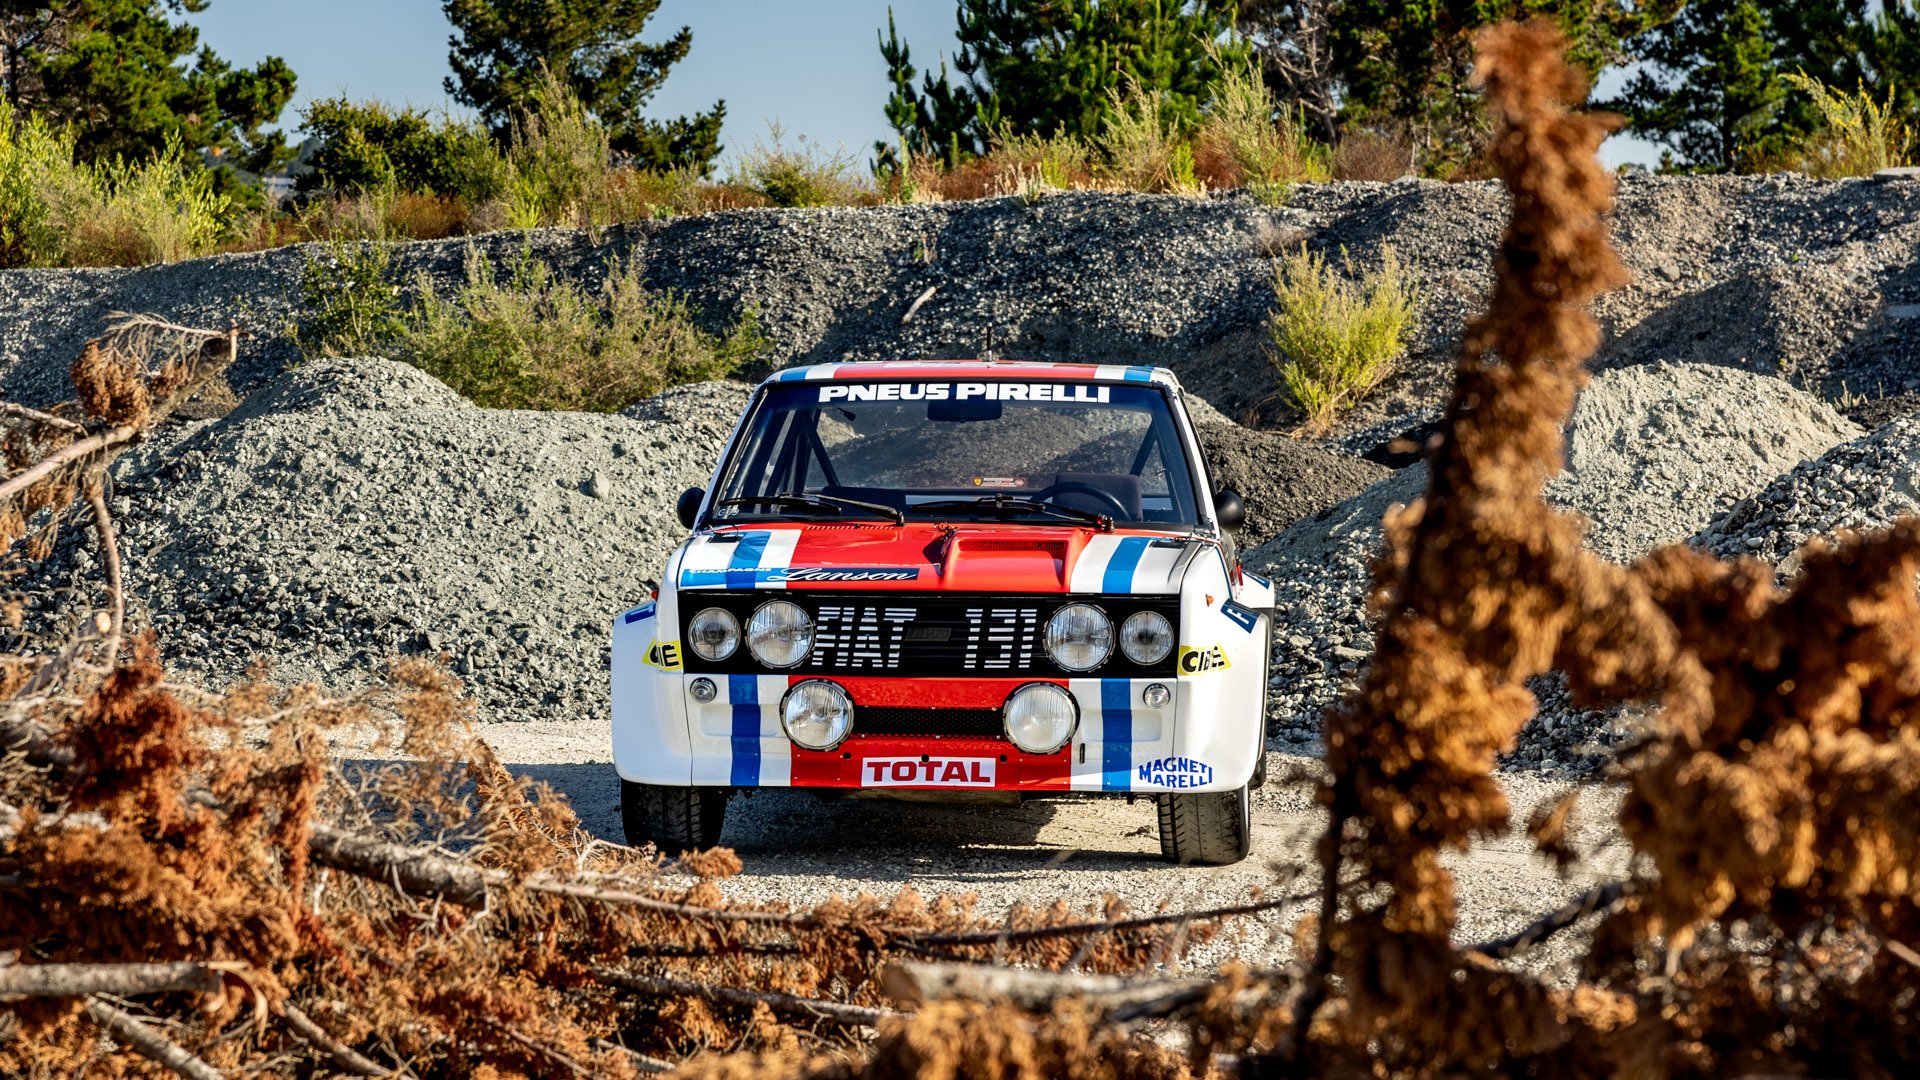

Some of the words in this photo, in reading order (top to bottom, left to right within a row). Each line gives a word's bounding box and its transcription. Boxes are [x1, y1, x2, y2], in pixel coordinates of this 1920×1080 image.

[818, 383, 950, 402] PNEUS
[955, 383, 1110, 403] PIRELLI
[766, 567, 917, 581] Lanson
[811, 607, 917, 667] FIAT
[964, 608, 1038, 668] 131
[866, 760, 991, 783] TOTAL
[1138, 757, 1213, 782] MAGNETI
[1138, 763, 1213, 788] MARELLI
